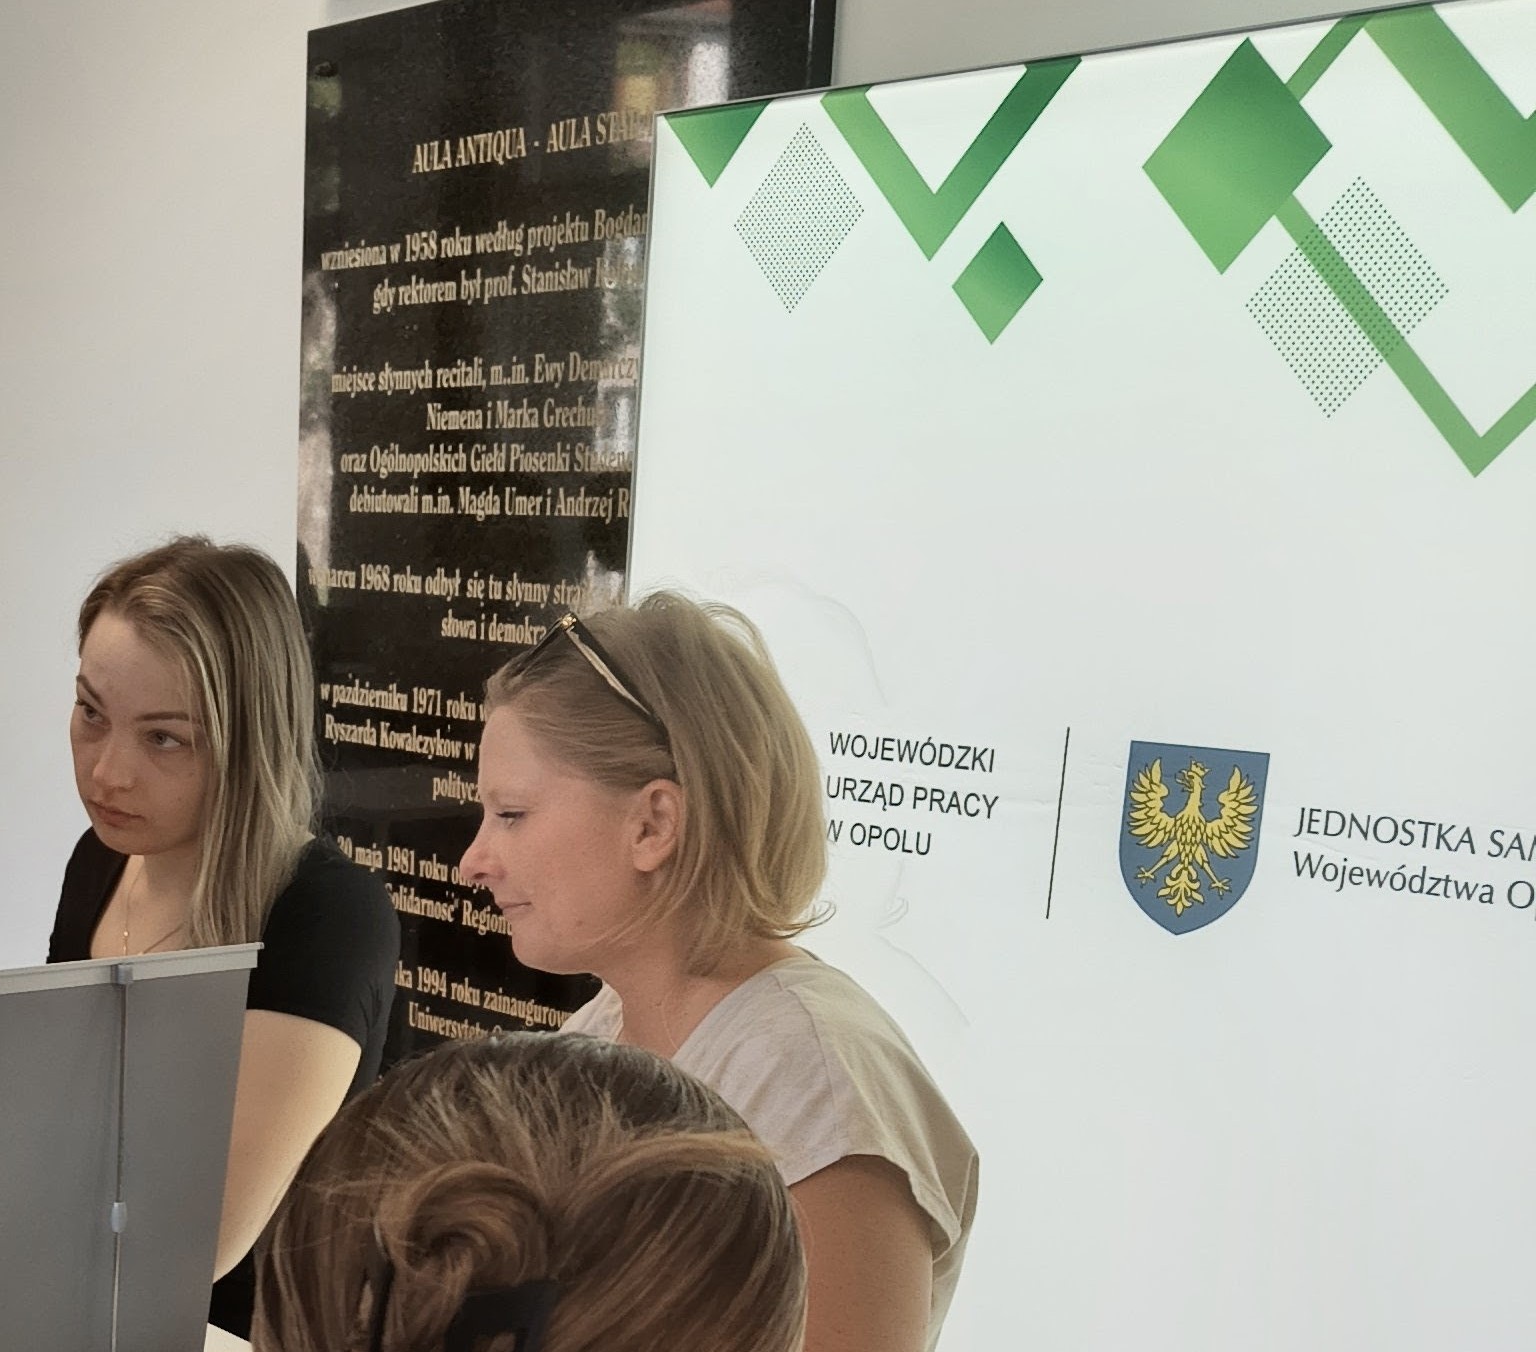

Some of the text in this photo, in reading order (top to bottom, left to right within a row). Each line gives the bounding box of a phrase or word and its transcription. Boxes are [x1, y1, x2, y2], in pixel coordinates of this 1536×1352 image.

[412, 143, 453, 174] AULA
[455, 126, 527, 167] ANTIQUA
[546, 116, 591, 153] AULA
[321, 239, 387, 270] wzniesiona
[389, 242, 402, 264] w
[404, 229, 437, 263] 1958
[440, 225, 472, 257] roku
[475, 219, 524, 257] według
[527, 210, 590, 253] projektu
[372, 278, 396, 315] gdy
[398, 274, 457, 307] rektorem
[460, 268, 482, 306] był
[482, 269, 517, 305] prof.
[521, 257, 592, 295] Stanisław
[331, 365, 376, 398] miejsce
[378, 360, 433, 396] słynnych
[436, 356, 487, 391] recitali,
[533, 352, 565, 389] Ewy
[425, 402, 483, 432] Niemena
[486, 400, 493, 430] i
[495, 398, 540, 430] Marka
[340, 452, 367, 474] oraz
[369, 442, 467, 479] Ogólnopolskich
[470, 443, 507, 473] Giełd
[509, 442, 571, 473] Piosenki
[349, 484, 418, 516] debiutowali
[421, 486, 455, 516] m.in.
[457, 486, 501, 523] Magda
[503, 486, 544, 517] Umer
[545, 486, 552, 516] i
[554, 486, 613, 525] Andrzej
[359, 562, 391, 593] 1968
[393, 565, 422, 595] roku
[425, 566, 462, 602] odbył
[466, 570, 487, 608] się
[488, 575, 503, 601] tu
[505, 571, 551, 606] słynny
[440, 611, 478, 640] słowa
[479, 613, 487, 641] i
[319, 682, 332, 702] w
[411, 685, 443, 719] 1971
[445, 690, 477, 722] roku
[324, 713, 476, 762] Ryszarda Kowalczyków w
[829, 730, 996, 774] WOJEWÓDZKI
[826, 775, 1000, 820] URZĄD PRACY
[849, 822, 932, 856] OPOLU
[1292, 806, 1477, 855] JEDNOSTKA
[355, 843, 384, 874] maja
[386, 845, 416, 877] 1981
[418, 852, 449, 883] roku
[1292, 849, 1536, 922] Województwa O
[416, 965, 448, 999] 1994
[450, 976, 481, 1007] roku
